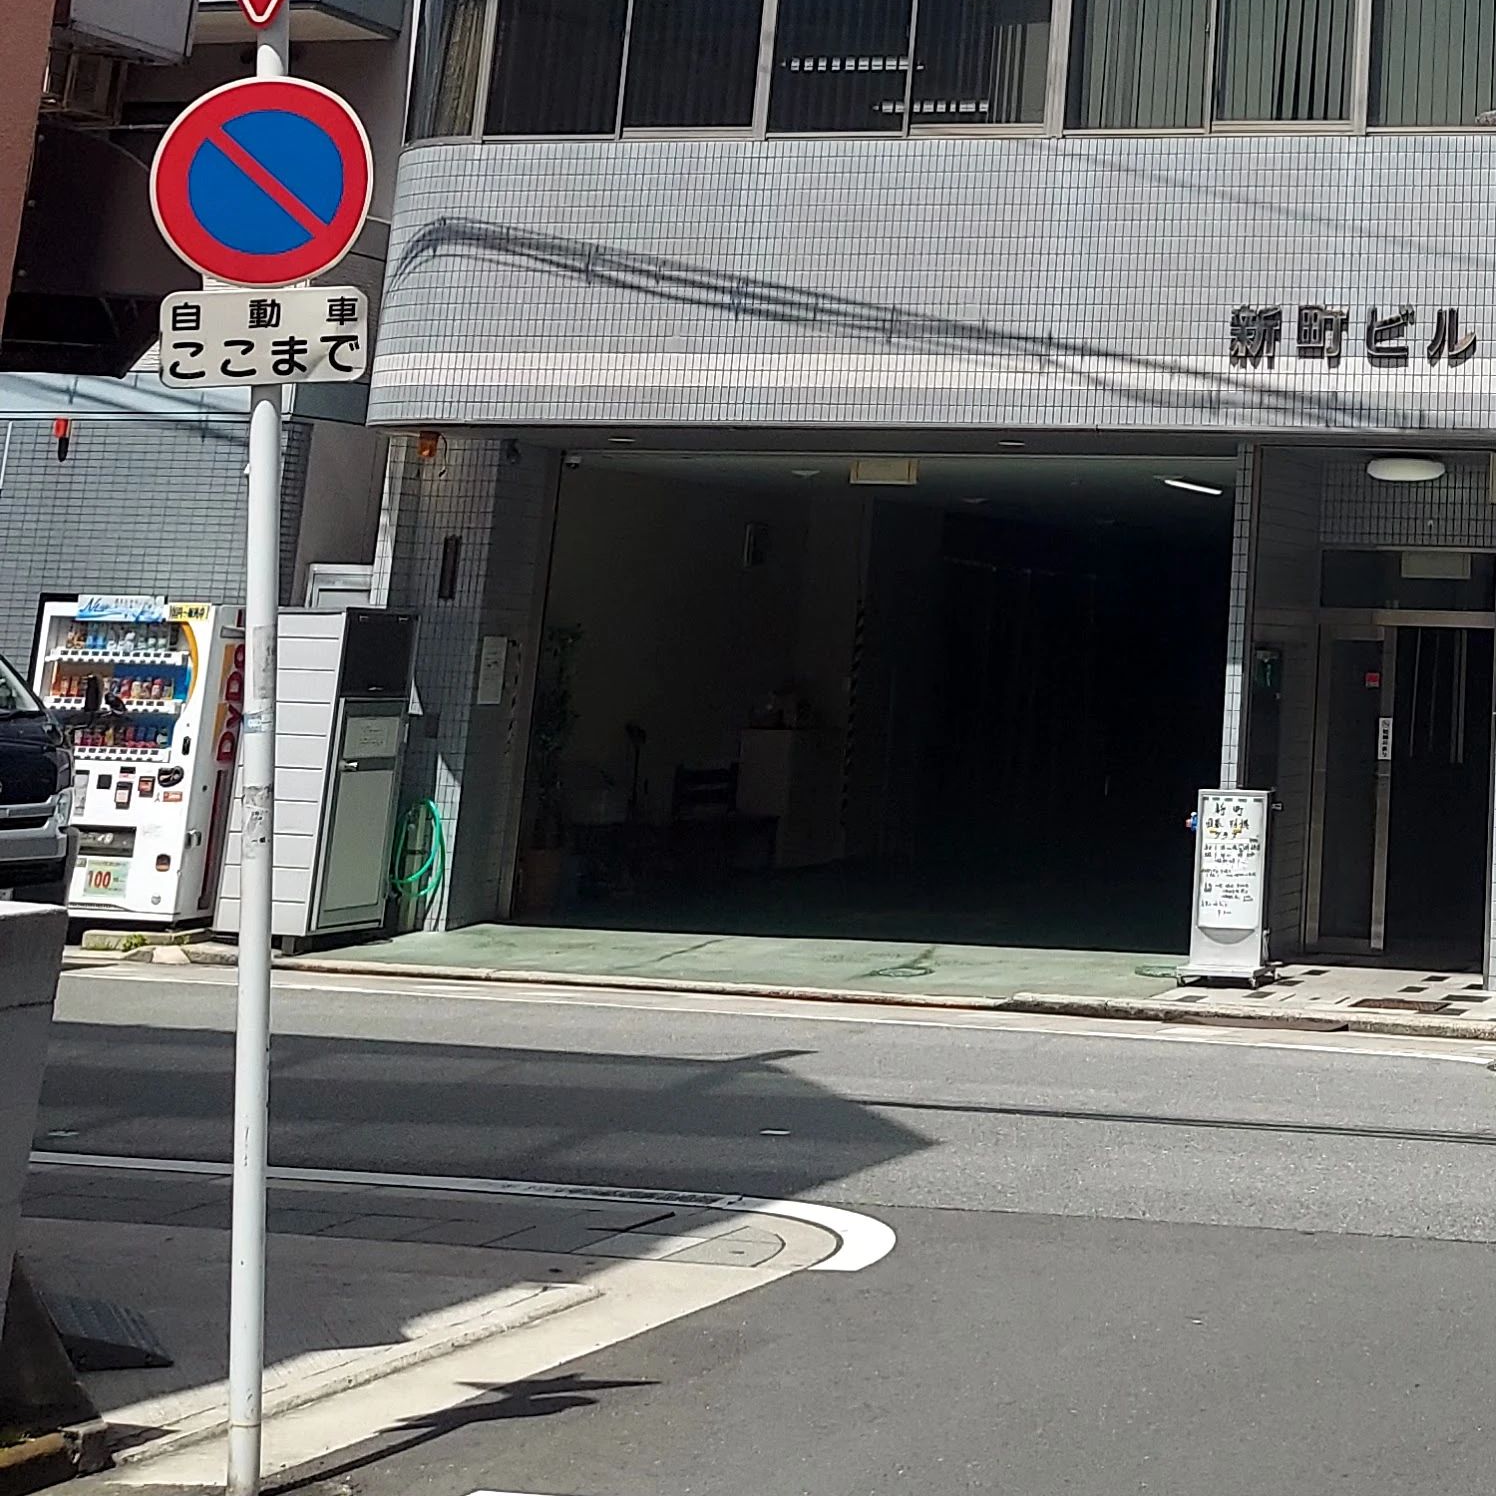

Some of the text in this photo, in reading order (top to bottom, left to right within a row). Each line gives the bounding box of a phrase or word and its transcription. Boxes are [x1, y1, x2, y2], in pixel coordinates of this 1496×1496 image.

[172, 295, 359, 332] 自動車
[1229, 304, 1477, 365] 新町ビル
[169, 334, 360, 380] ここまで
[88, 870, 112, 889] 100
